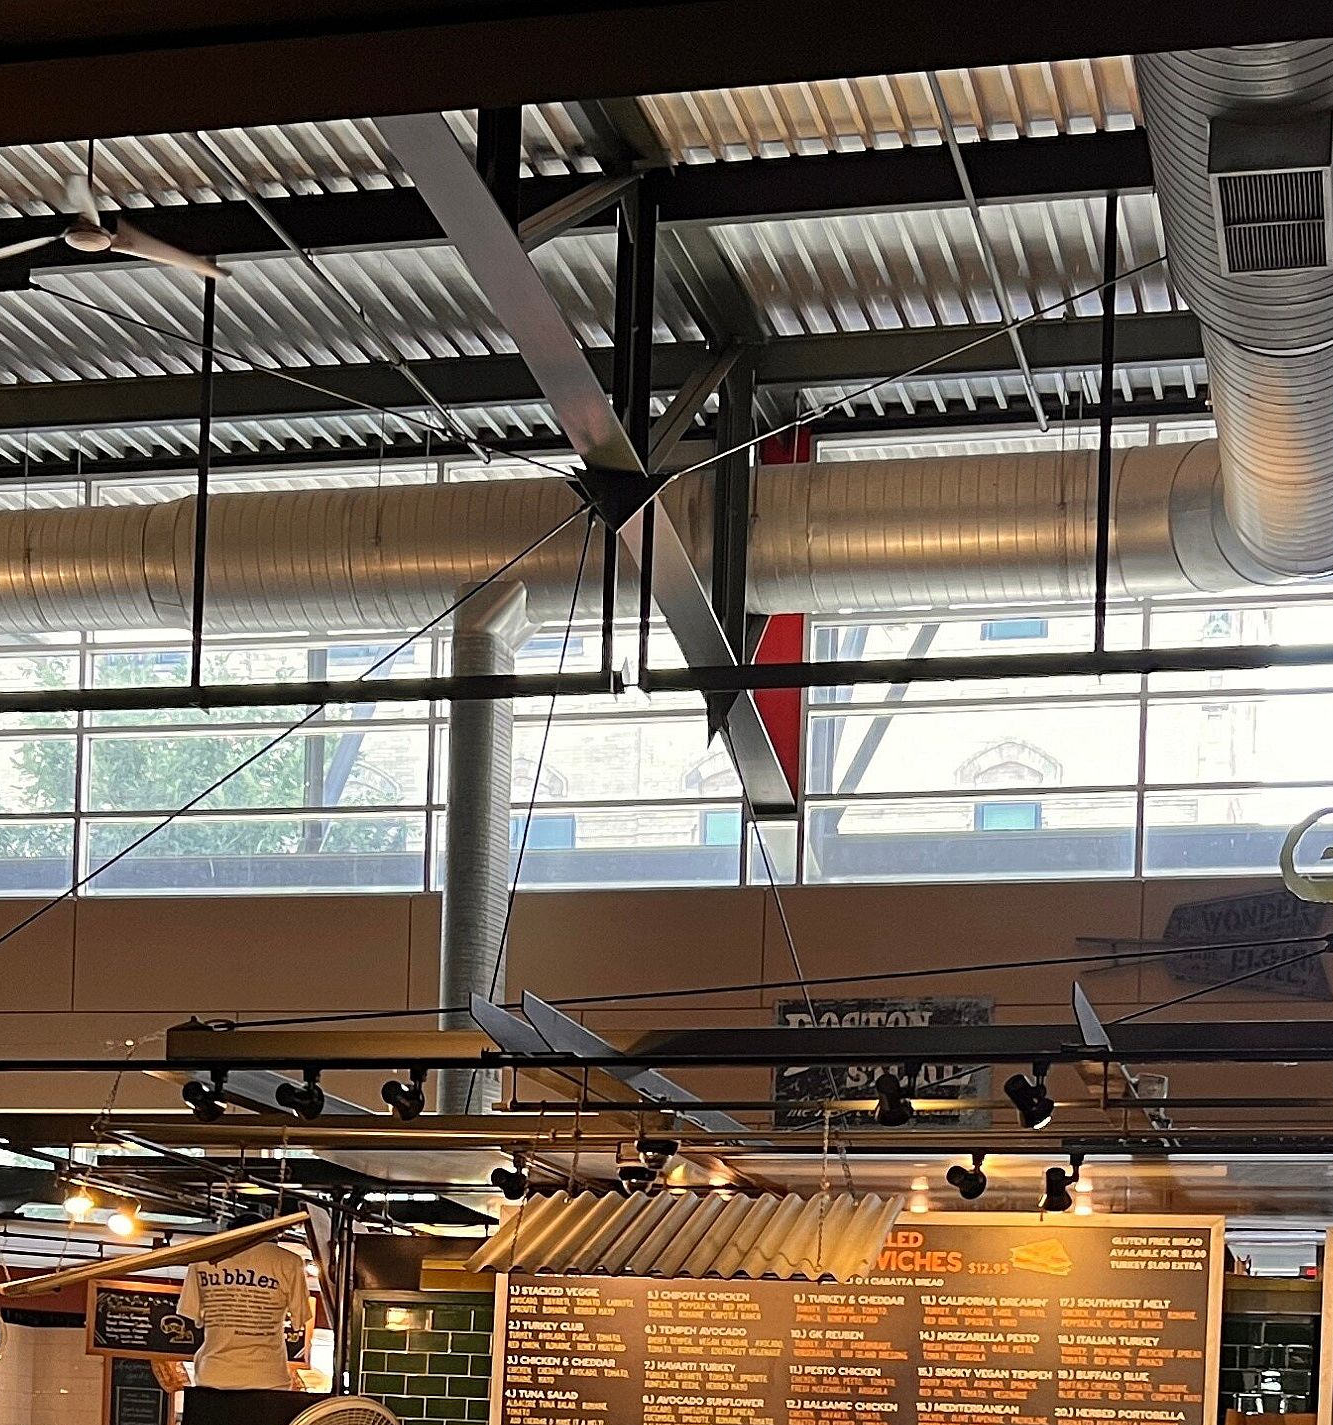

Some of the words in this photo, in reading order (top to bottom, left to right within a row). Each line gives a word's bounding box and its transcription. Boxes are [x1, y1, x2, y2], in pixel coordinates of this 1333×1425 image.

[1112, 1236, 1146, 1246] GLUTEN
[1148, 1237, 1170, 1246] FREE
[1172, 1238, 1203, 1246] BREAD
[1110, 1248, 1158, 1258] AVAILABLE
[1160, 1250, 1180, 1258] FOR
[968, 1263, 1009, 1274] $12.95
[1110, 1260, 1146, 1270] TURKEY
[1172, 1262, 1202, 1272] EXTRA
[197, 1268, 280, 1291] Bubbler
[870, 1278, 913, 1286] CIABATTA
[521, 1286, 564, 1297] STACKED
[566, 1287, 599, 1298] VEGGIE
[661, 1291, 705, 1301] CHIPOTLE
[707, 1292, 750, 1302] CHICKEN
[808, 1295, 846, 1305] TURKEY
[858, 1296, 904, 1306] CHEDDAR
[938, 1296, 997, 1307] CALIFORNIA
[1077, 1298, 1141, 1309] SOUTHWEST
[1143, 1300, 1170, 1310] MELT
[522, 1321, 558, 1332] TURKEY
[560, 1322, 584, 1332] CLUB
[699, 1327, 747, 1337] AVOCADO
[826, 1331, 864, 1340] REUBEN
[937, 1332, 1004, 1343] MOZZARELLA
[1007, 1333, 1040, 1343] PESTO
[1076, 1335, 1116, 1346] ITALIAN
[1119, 1336, 1159, 1347] TURKEY
[520, 1356, 561, 1366] CHICKEN
[571, 1358, 616, 1368] CHEDDAR
[657, 1362, 697, 1372] HAVARTI
[699, 1363, 736, 1373] TURKEY
[805, 1365, 835, 1376] PESTO
[838, 1367, 881, 1377] CHICKEN
[935, 1368, 971, 1378] SMOKY
[974, 1369, 1009, 1379] VEGAN
[1012, 1370, 1052, 1380] TEMPEH
[1076, 1370, 1121, 1382] BUFFALO
[1124, 1372, 1149, 1382] BLUE
[519, 1390, 545, 1399] TUNA
[547, 1391, 578, 1400] SALAD
[657, 1395, 704, 1406] AVOCADO
[706, 1397, 764, 1408] SUNFLOWER
[803, 1400, 852, 1411] BALSAMIC
[855, 1401, 898, 1412] CHICKEN
[934, 1403, 1019, 1415] MEDITERRANEAN
[1076, 1408, 1116, 1419] HERBED
[1118, 1410, 1186, 1421] PORTOBELLA
